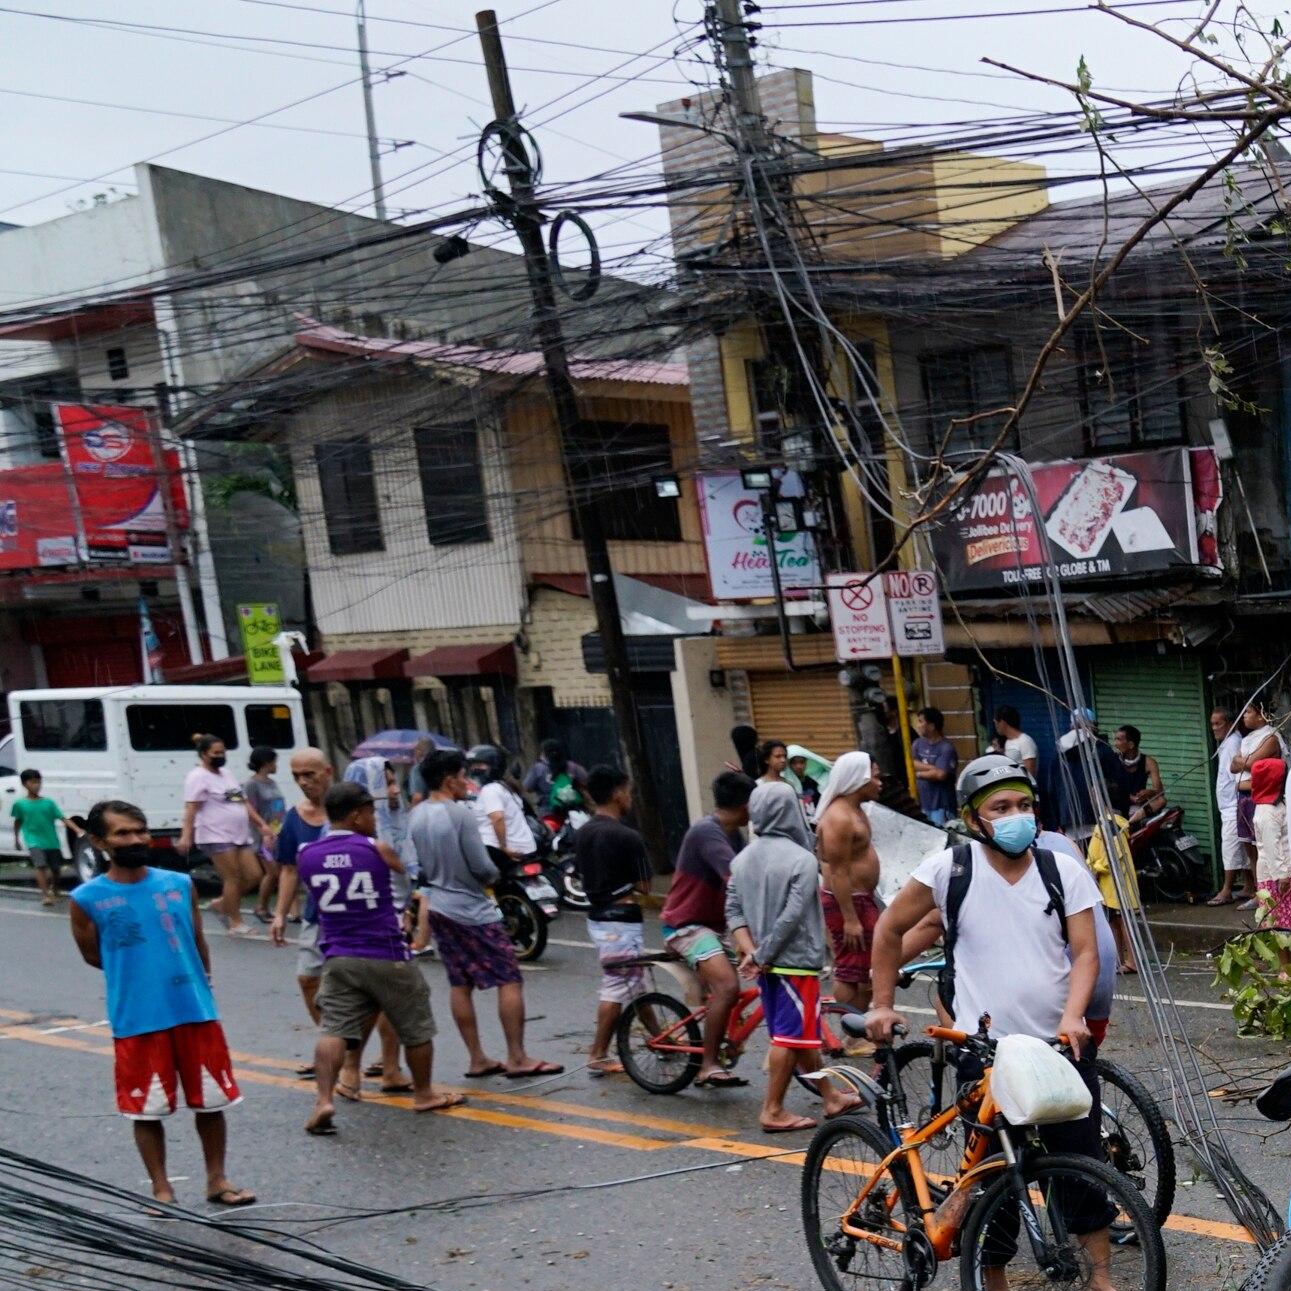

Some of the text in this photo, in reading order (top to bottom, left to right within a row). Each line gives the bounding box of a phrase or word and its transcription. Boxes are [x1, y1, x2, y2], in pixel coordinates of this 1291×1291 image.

[1060, 562, 1087, 577] GLOBE
[1088, 560, 1097, 573] &
[1096, 559, 1111, 572] TM
[889, 573, 910, 598] NO
[853, 614, 868, 622] NO
[838, 624, 886, 635] STOPPING
[253, 647, 279, 658] BIKE
[254, 660, 283, 671] LANE
[311, 871, 379, 912] 24
